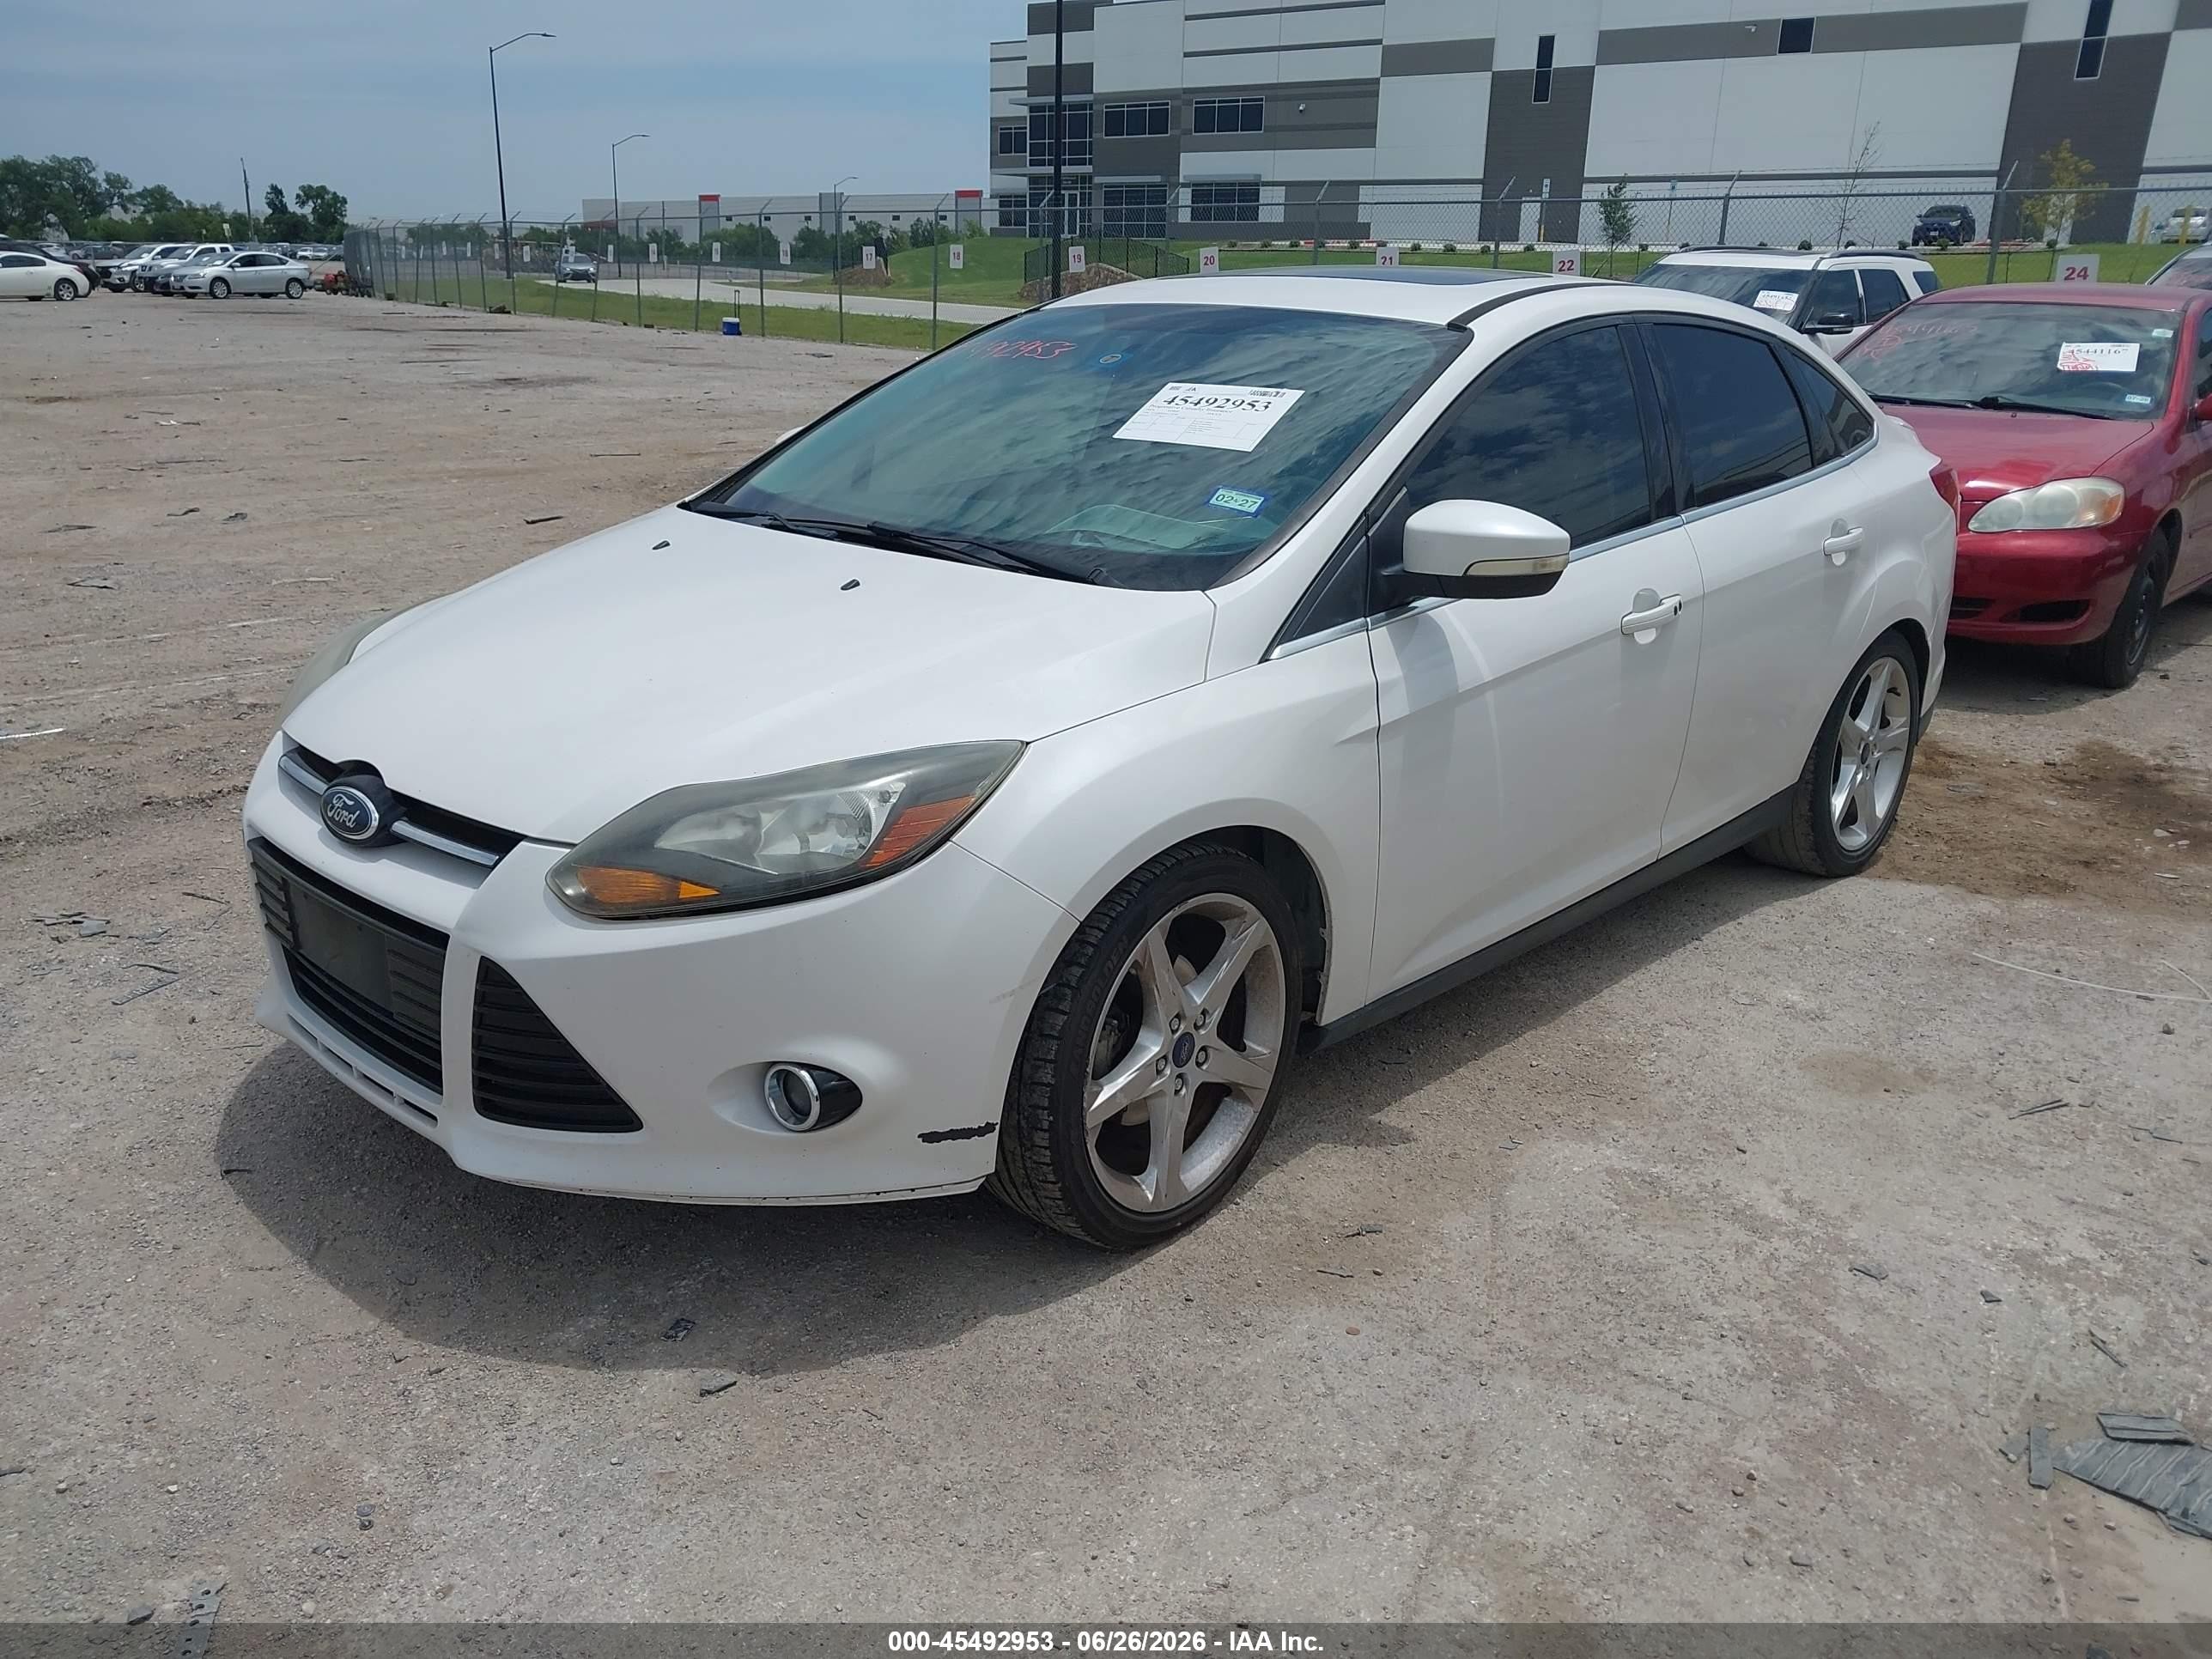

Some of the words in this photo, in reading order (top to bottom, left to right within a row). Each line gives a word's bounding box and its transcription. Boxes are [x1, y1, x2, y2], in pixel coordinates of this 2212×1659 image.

[866, 252, 873, 262] 17
[1072, 253, 1082, 264] 19
[1203, 255, 1216, 266] 20
[1380, 256, 1394, 266] 21
[1558, 259, 1575, 273] 22
[2063, 266, 2089, 281] 24
[1163, 394, 1273, 413] 45492953
[327, 793, 361, 828] Ford
